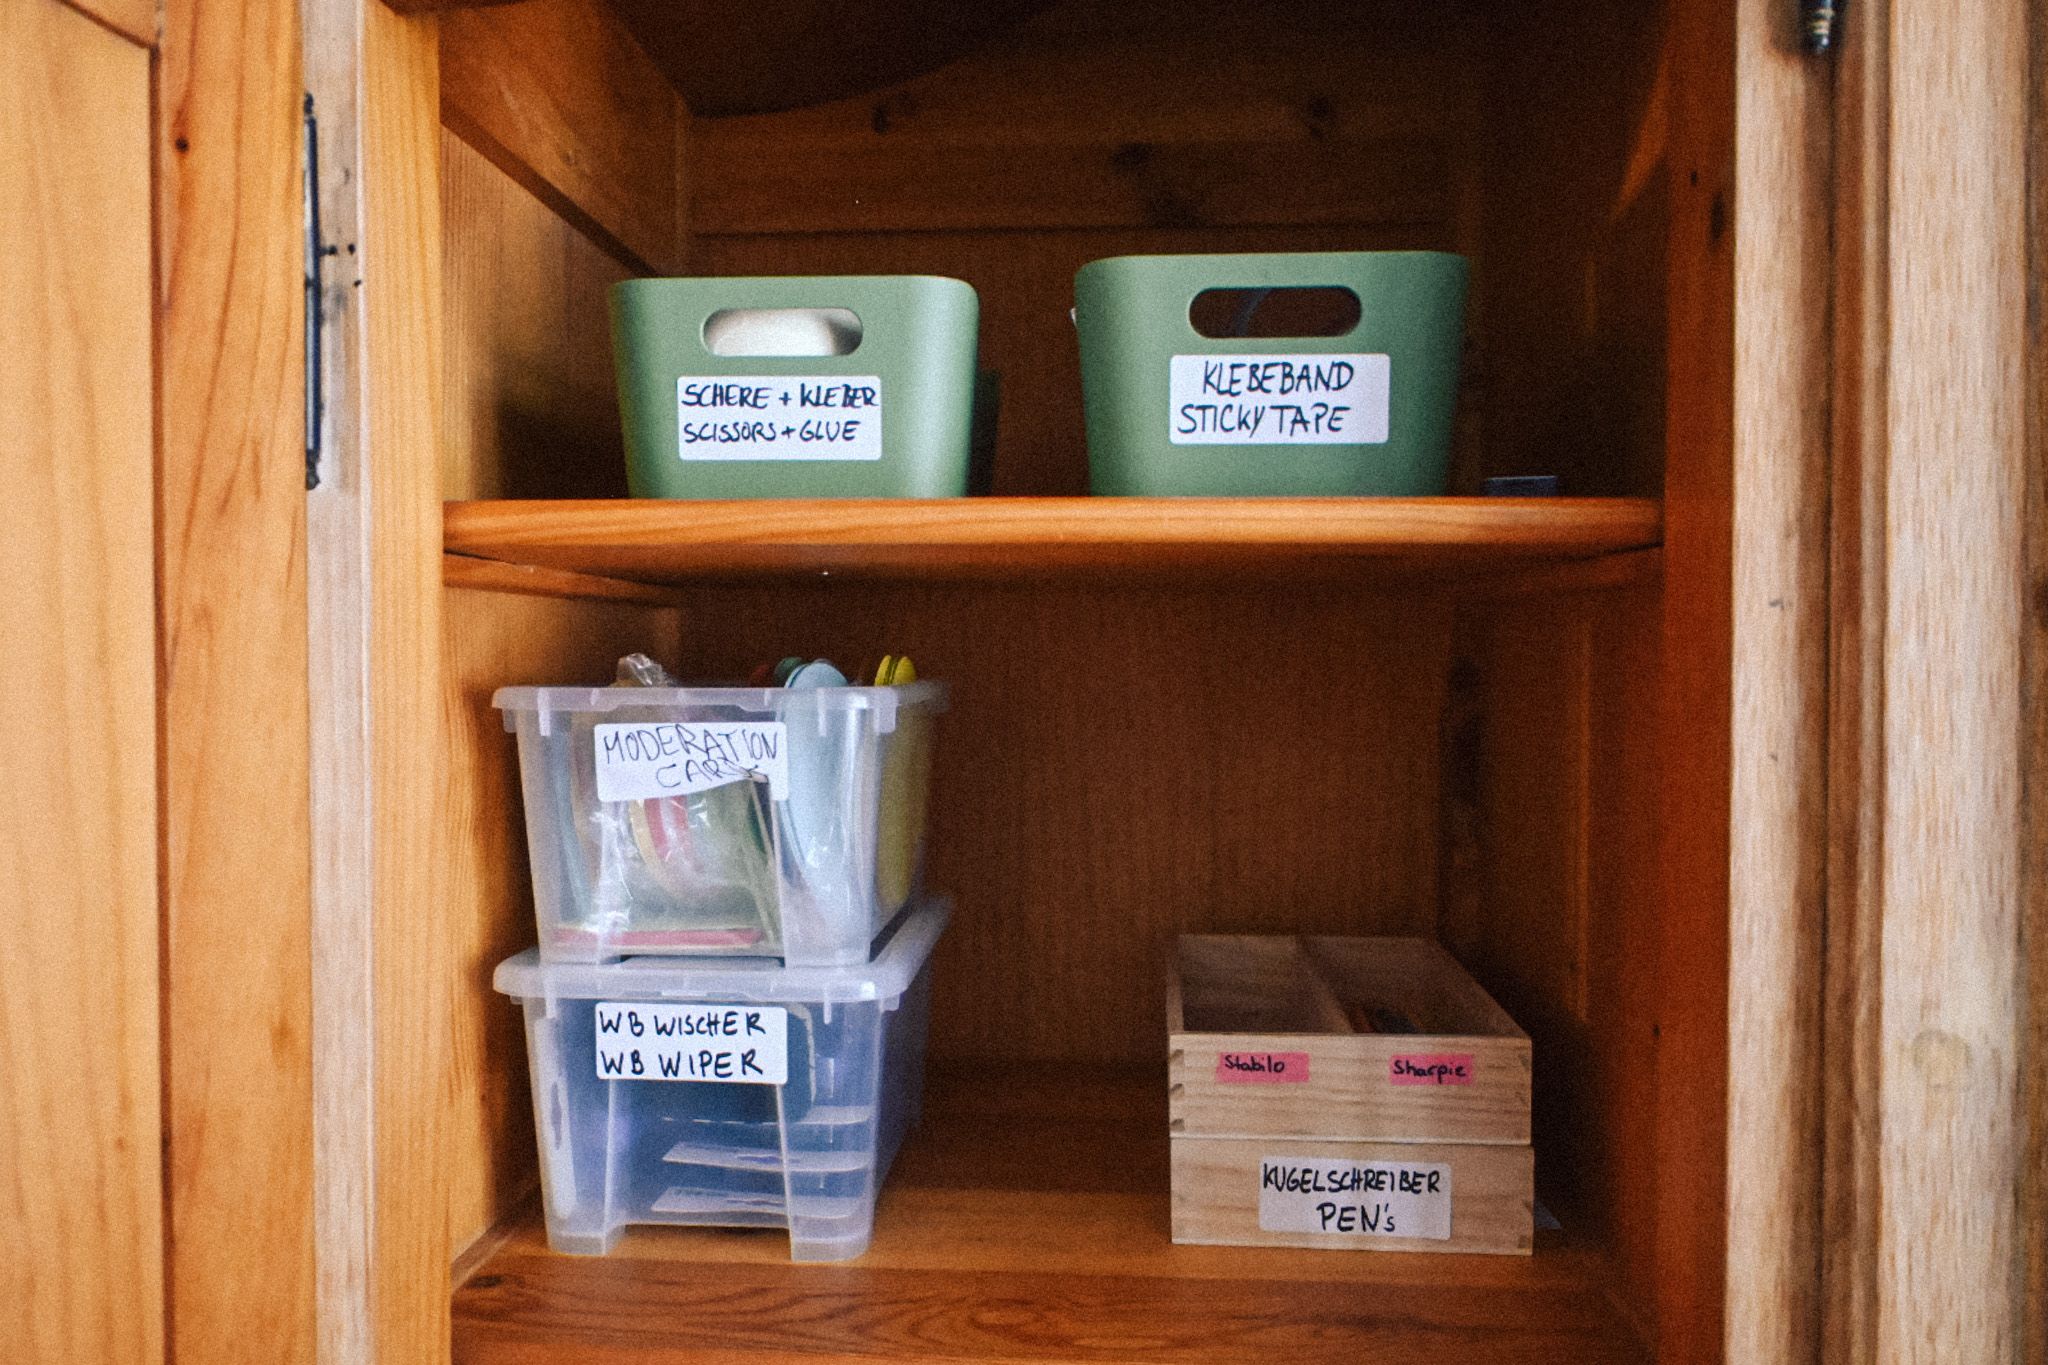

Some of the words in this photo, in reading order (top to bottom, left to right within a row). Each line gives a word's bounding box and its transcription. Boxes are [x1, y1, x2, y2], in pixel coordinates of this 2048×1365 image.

[1203, 360, 1354, 397] KLEBEBAND
[682, 383, 773, 409] SCHERE
[800, 382, 880, 409] KLEBER
[1269, 402, 1352, 437] TAPE
[603, 724, 778, 764] MODERATION
[654, 1011, 767, 1037] WISCHER
[658, 1048, 764, 1078] WIPER
[1224, 1055, 1286, 1074] Stabilo
[1393, 1059, 1467, 1085] Sharpie
[1263, 1162, 1441, 1195] KUGELSCHREIBER
